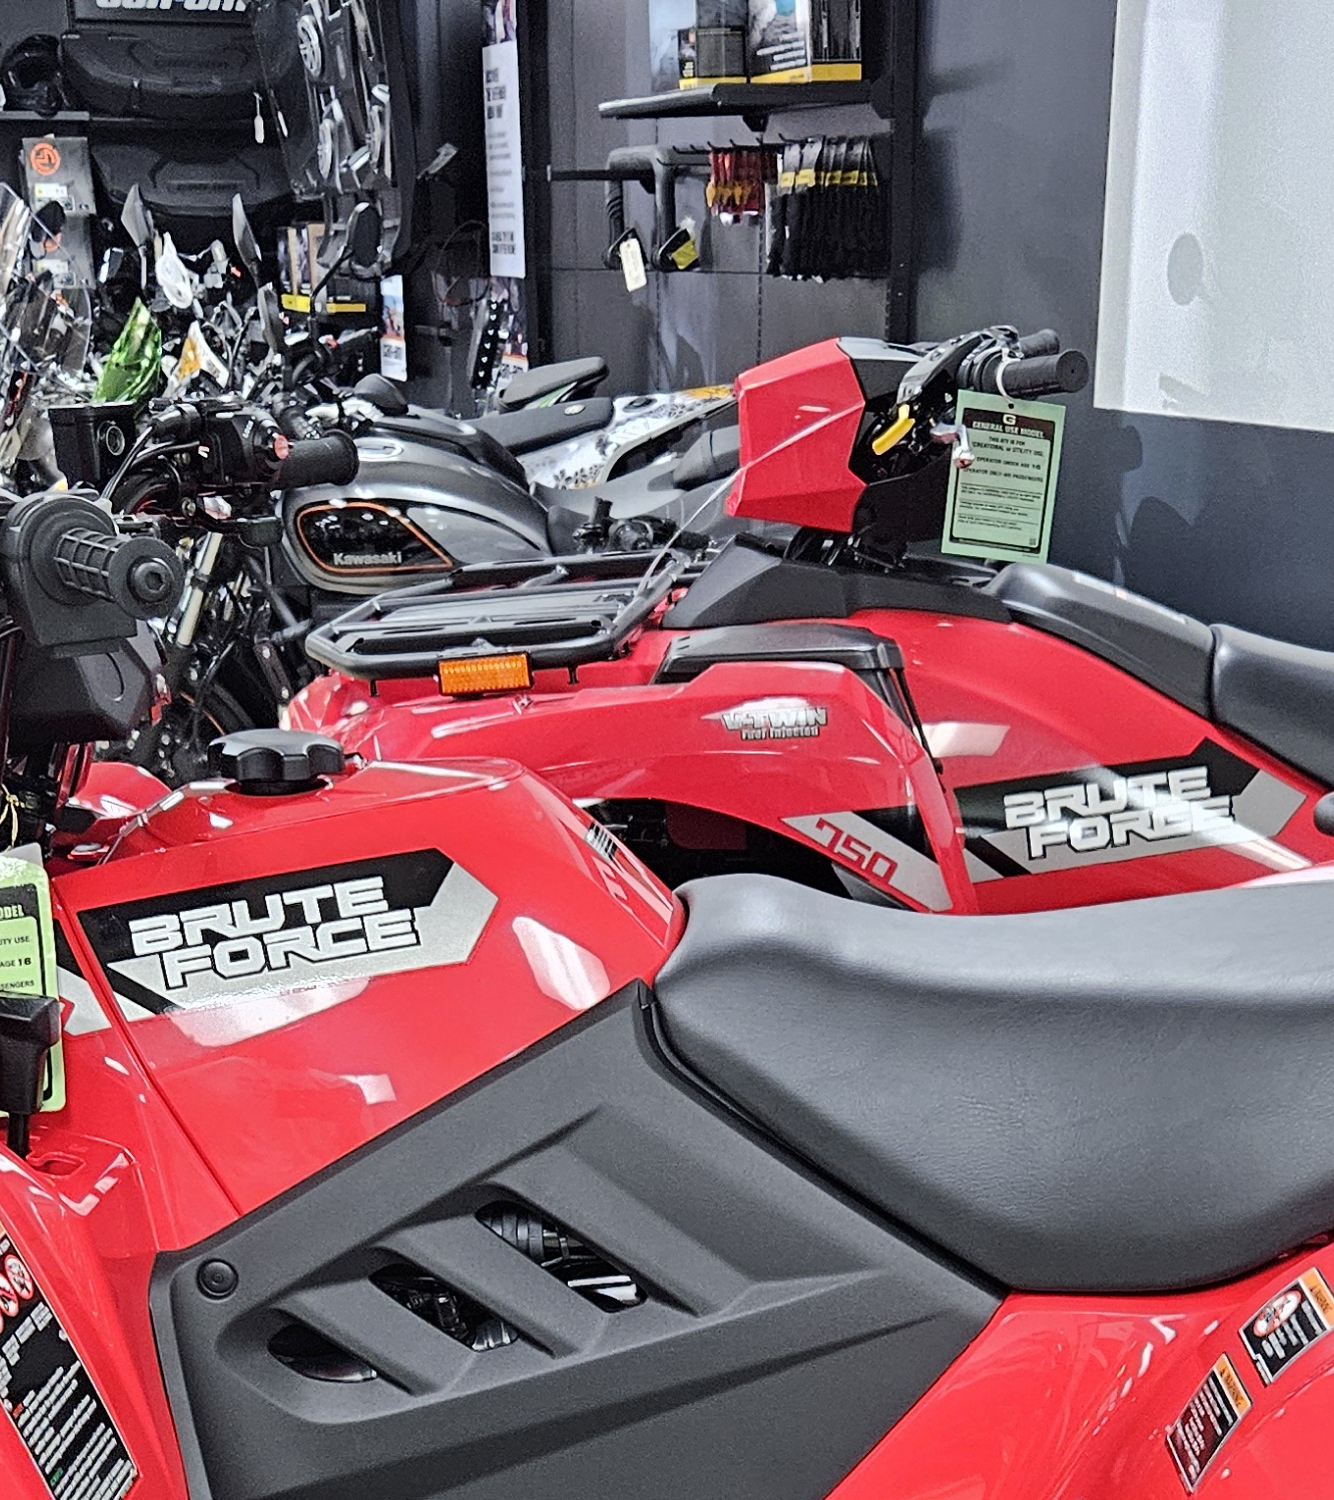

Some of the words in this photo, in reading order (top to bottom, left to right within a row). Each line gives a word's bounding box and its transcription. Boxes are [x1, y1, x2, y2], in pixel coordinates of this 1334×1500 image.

[972, 421, 1003, 433] GENERAL
[1005, 425, 1019, 435] USE
[1020, 427, 1045, 438] MODEL
[1002, 414, 1016, 425] G
[333, 552, 402, 565] Kawasaki
[769, 725, 820, 739] Injected
[1003, 766, 1211, 829] BRUTE
[1028, 795, 1237, 860] FORCE
[814, 816, 898, 886] 750
[128, 876, 389, 957] BRUTE
[0, 960, 16, 968] AGE
[18, 957, 32, 966] 16
[164, 908, 417, 990] FORCE
